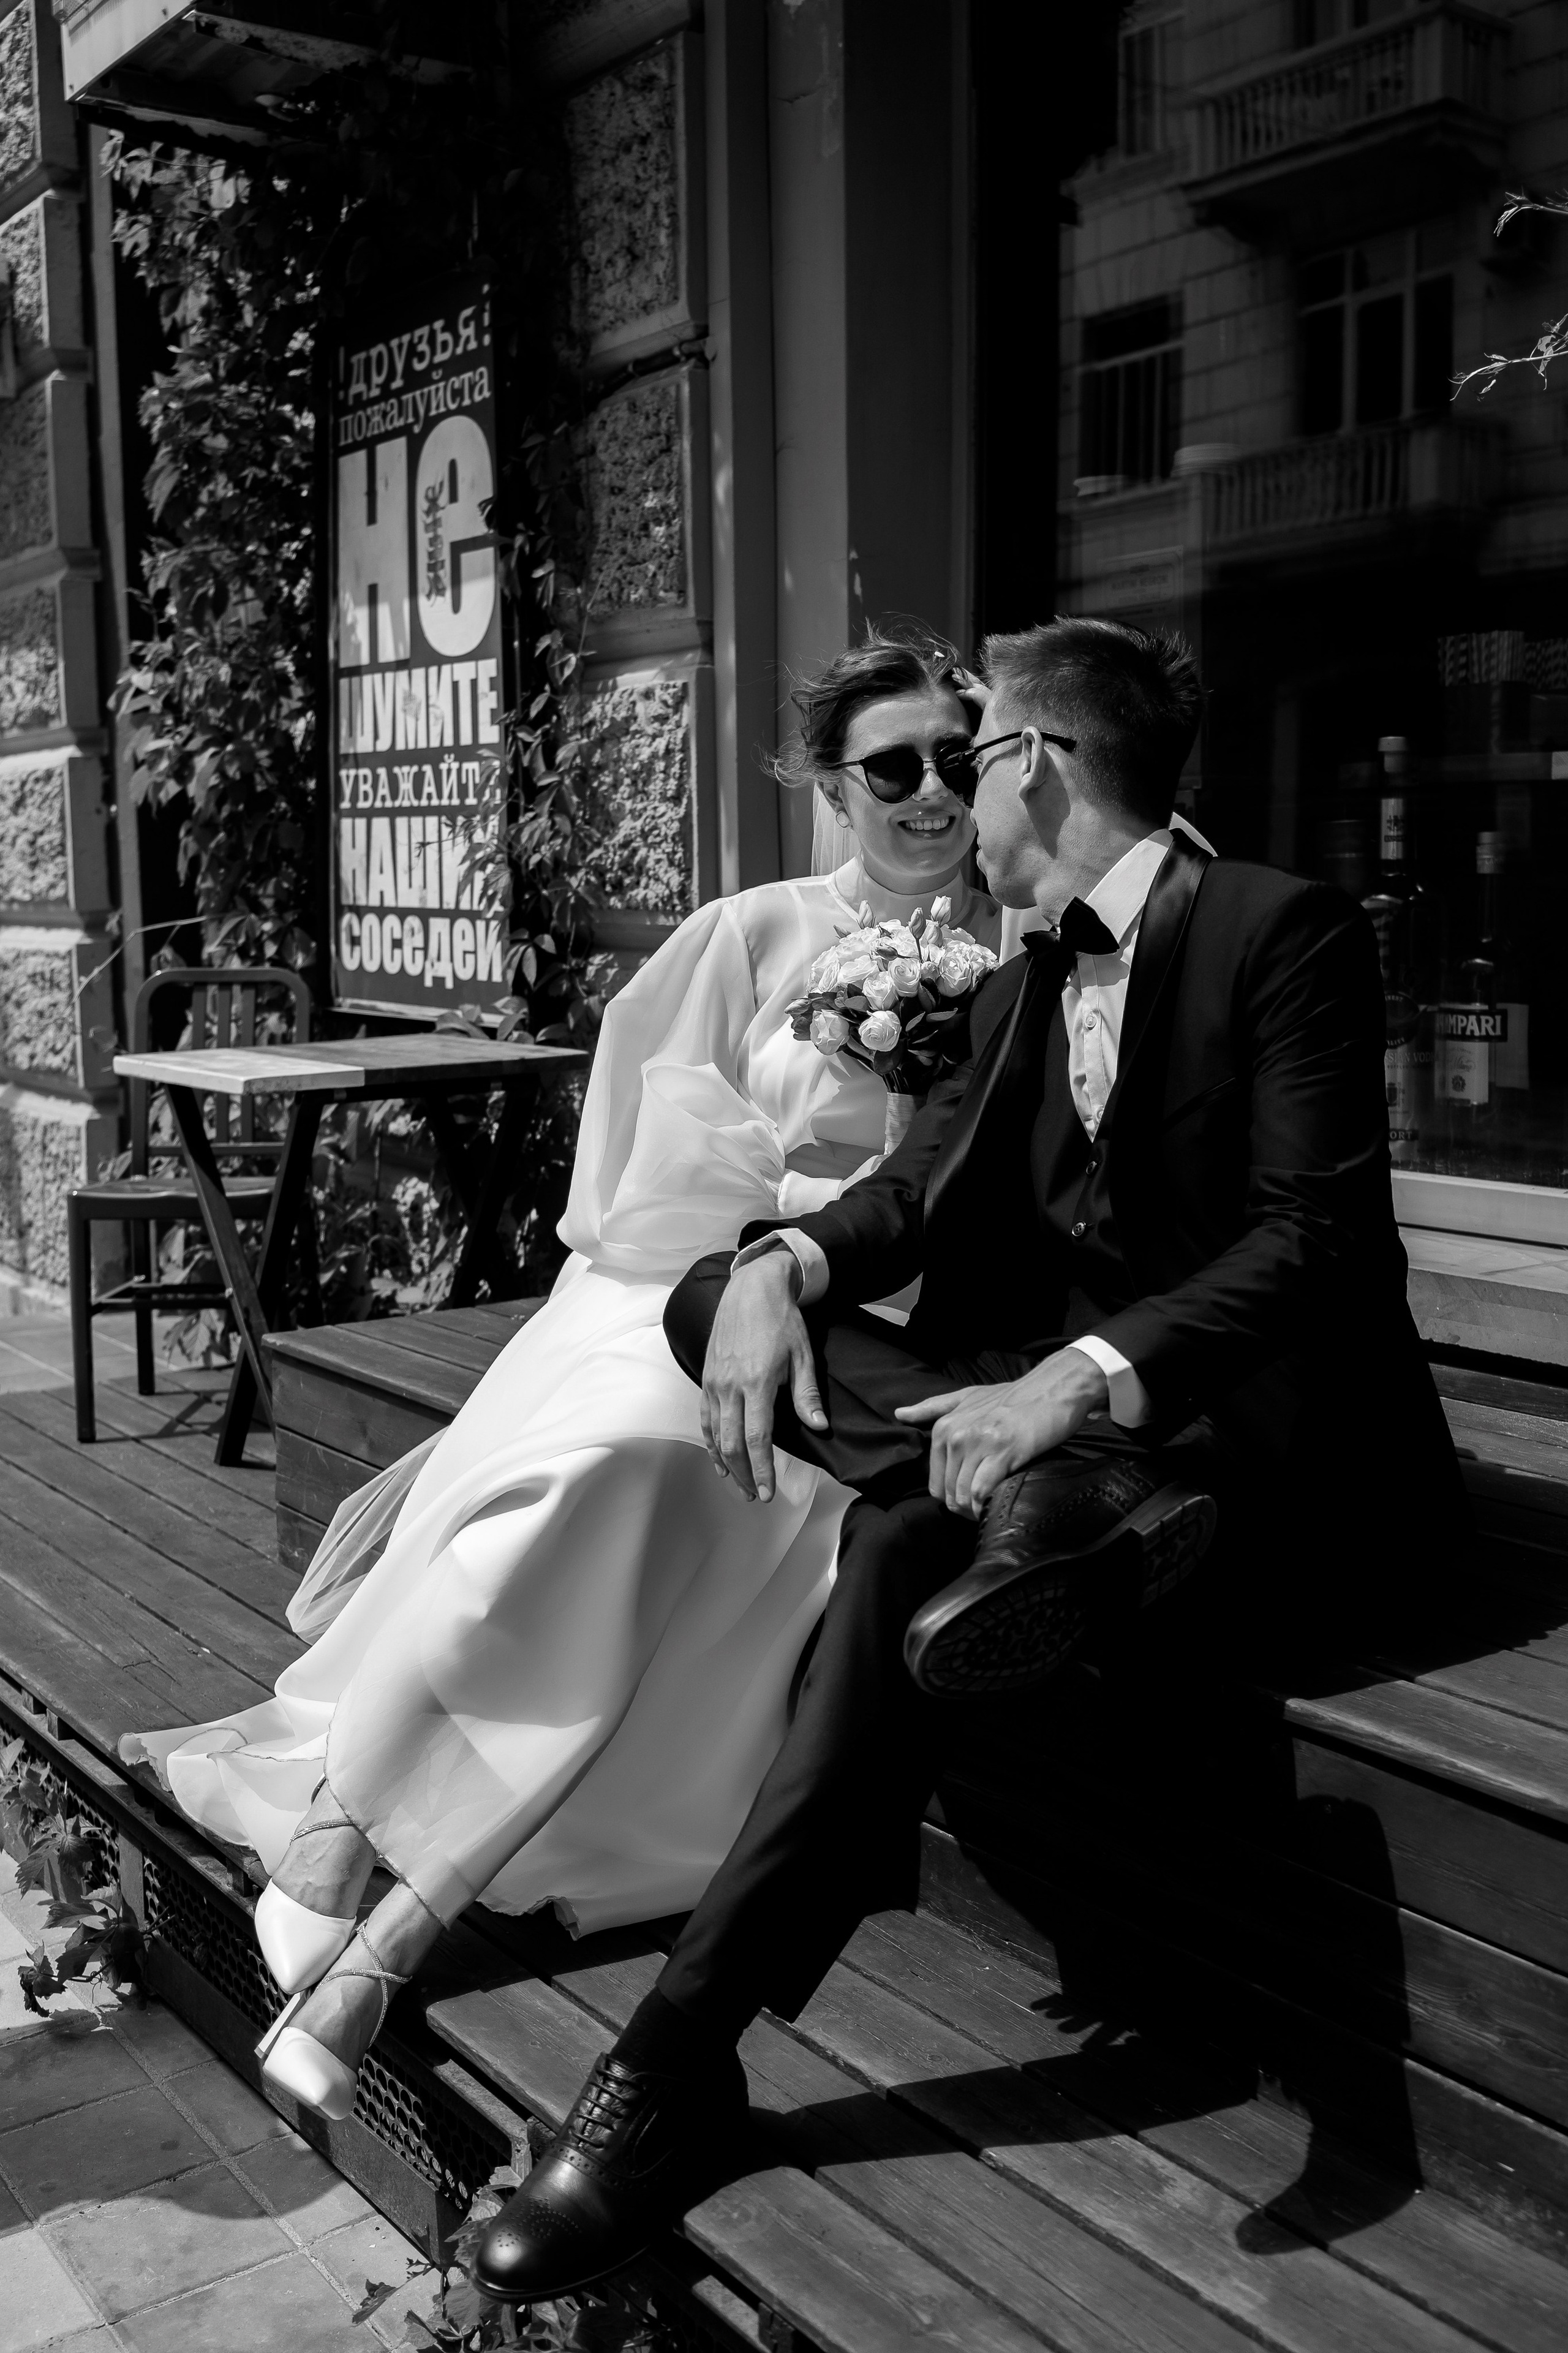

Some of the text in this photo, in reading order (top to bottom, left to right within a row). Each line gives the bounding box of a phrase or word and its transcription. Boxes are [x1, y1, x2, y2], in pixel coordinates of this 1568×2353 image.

[338, 366, 492, 446] пожалуйста
[339, 657, 500, 755] ШУМИТЕ
[1436, 1014, 1502, 1037] MPARI
[1389, 1131, 1412, 1140] ORT
